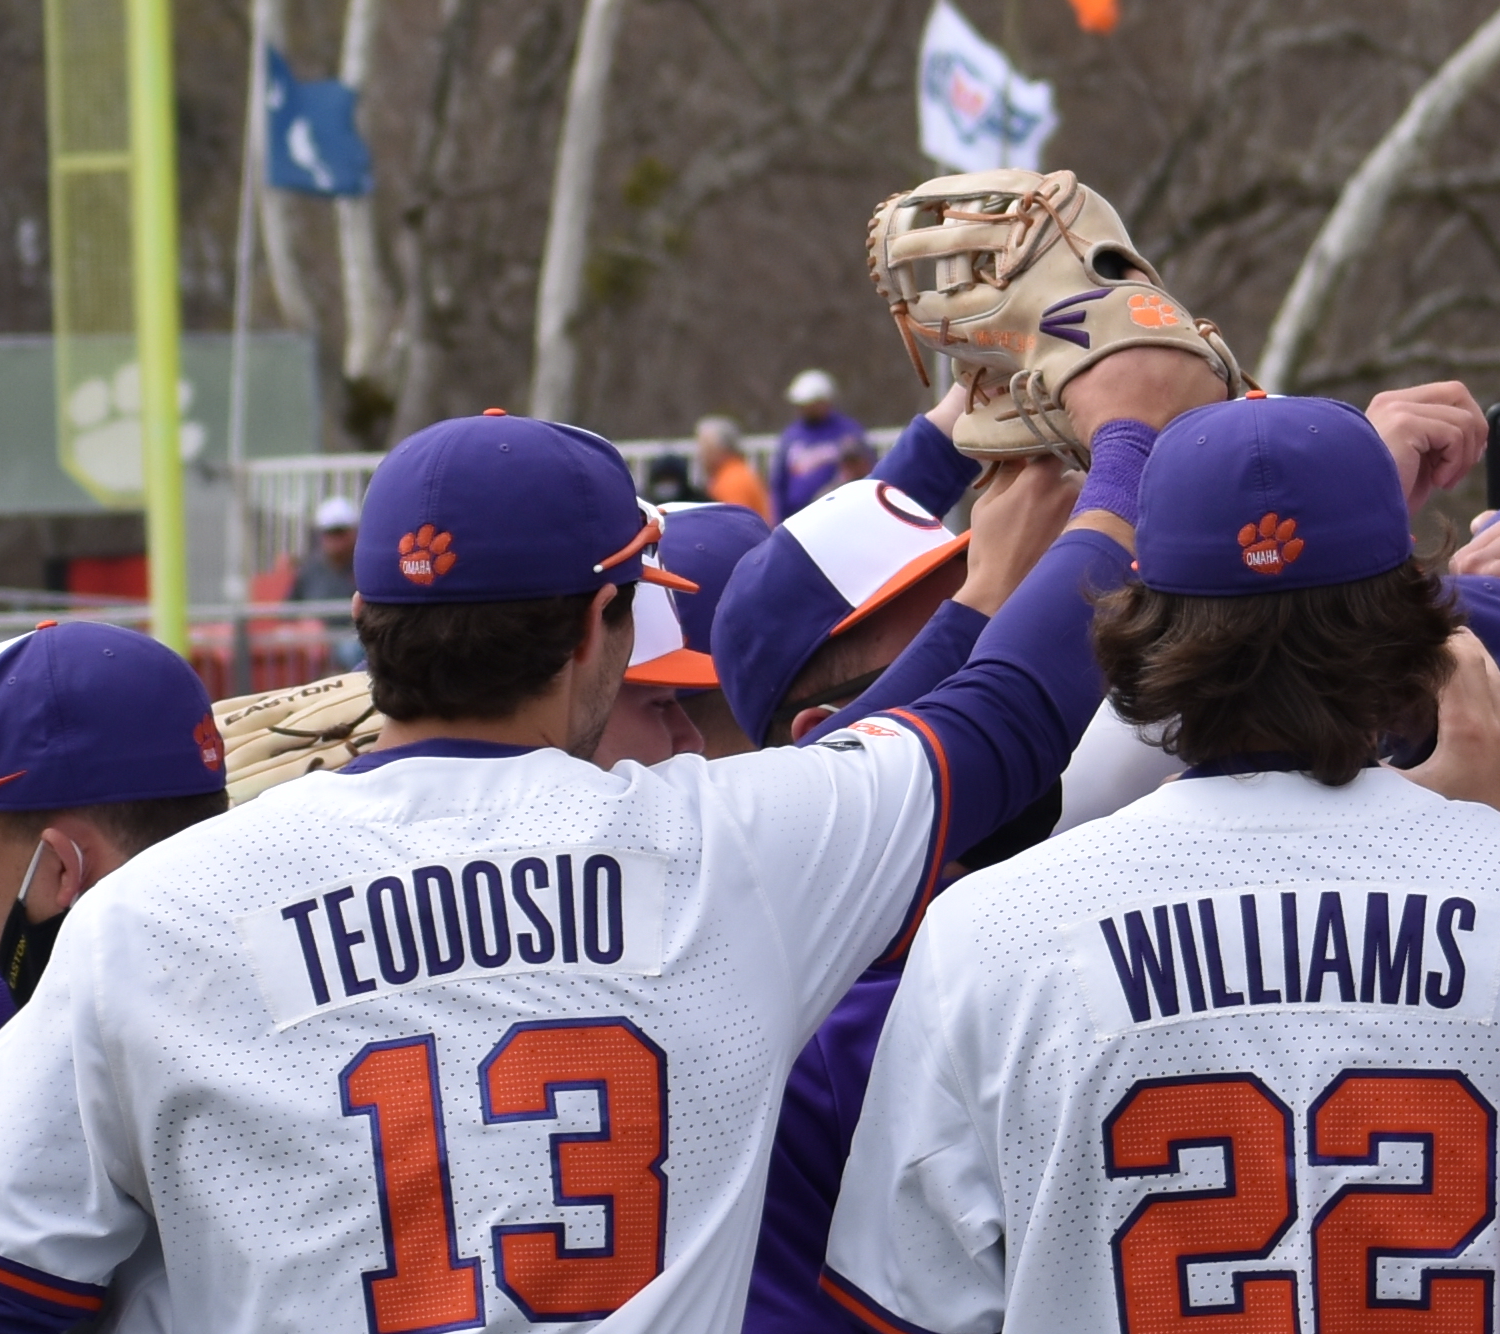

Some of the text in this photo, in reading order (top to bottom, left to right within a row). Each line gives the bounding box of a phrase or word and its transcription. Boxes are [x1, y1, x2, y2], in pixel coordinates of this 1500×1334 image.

[402, 559, 432, 575] OMAHA
[1246, 549, 1279, 566] OMAHA
[224, 679, 344, 726] EASTON
[280, 853, 625, 1005] TEODOSIO
[1099, 890, 1477, 1023] WILLIAMS
